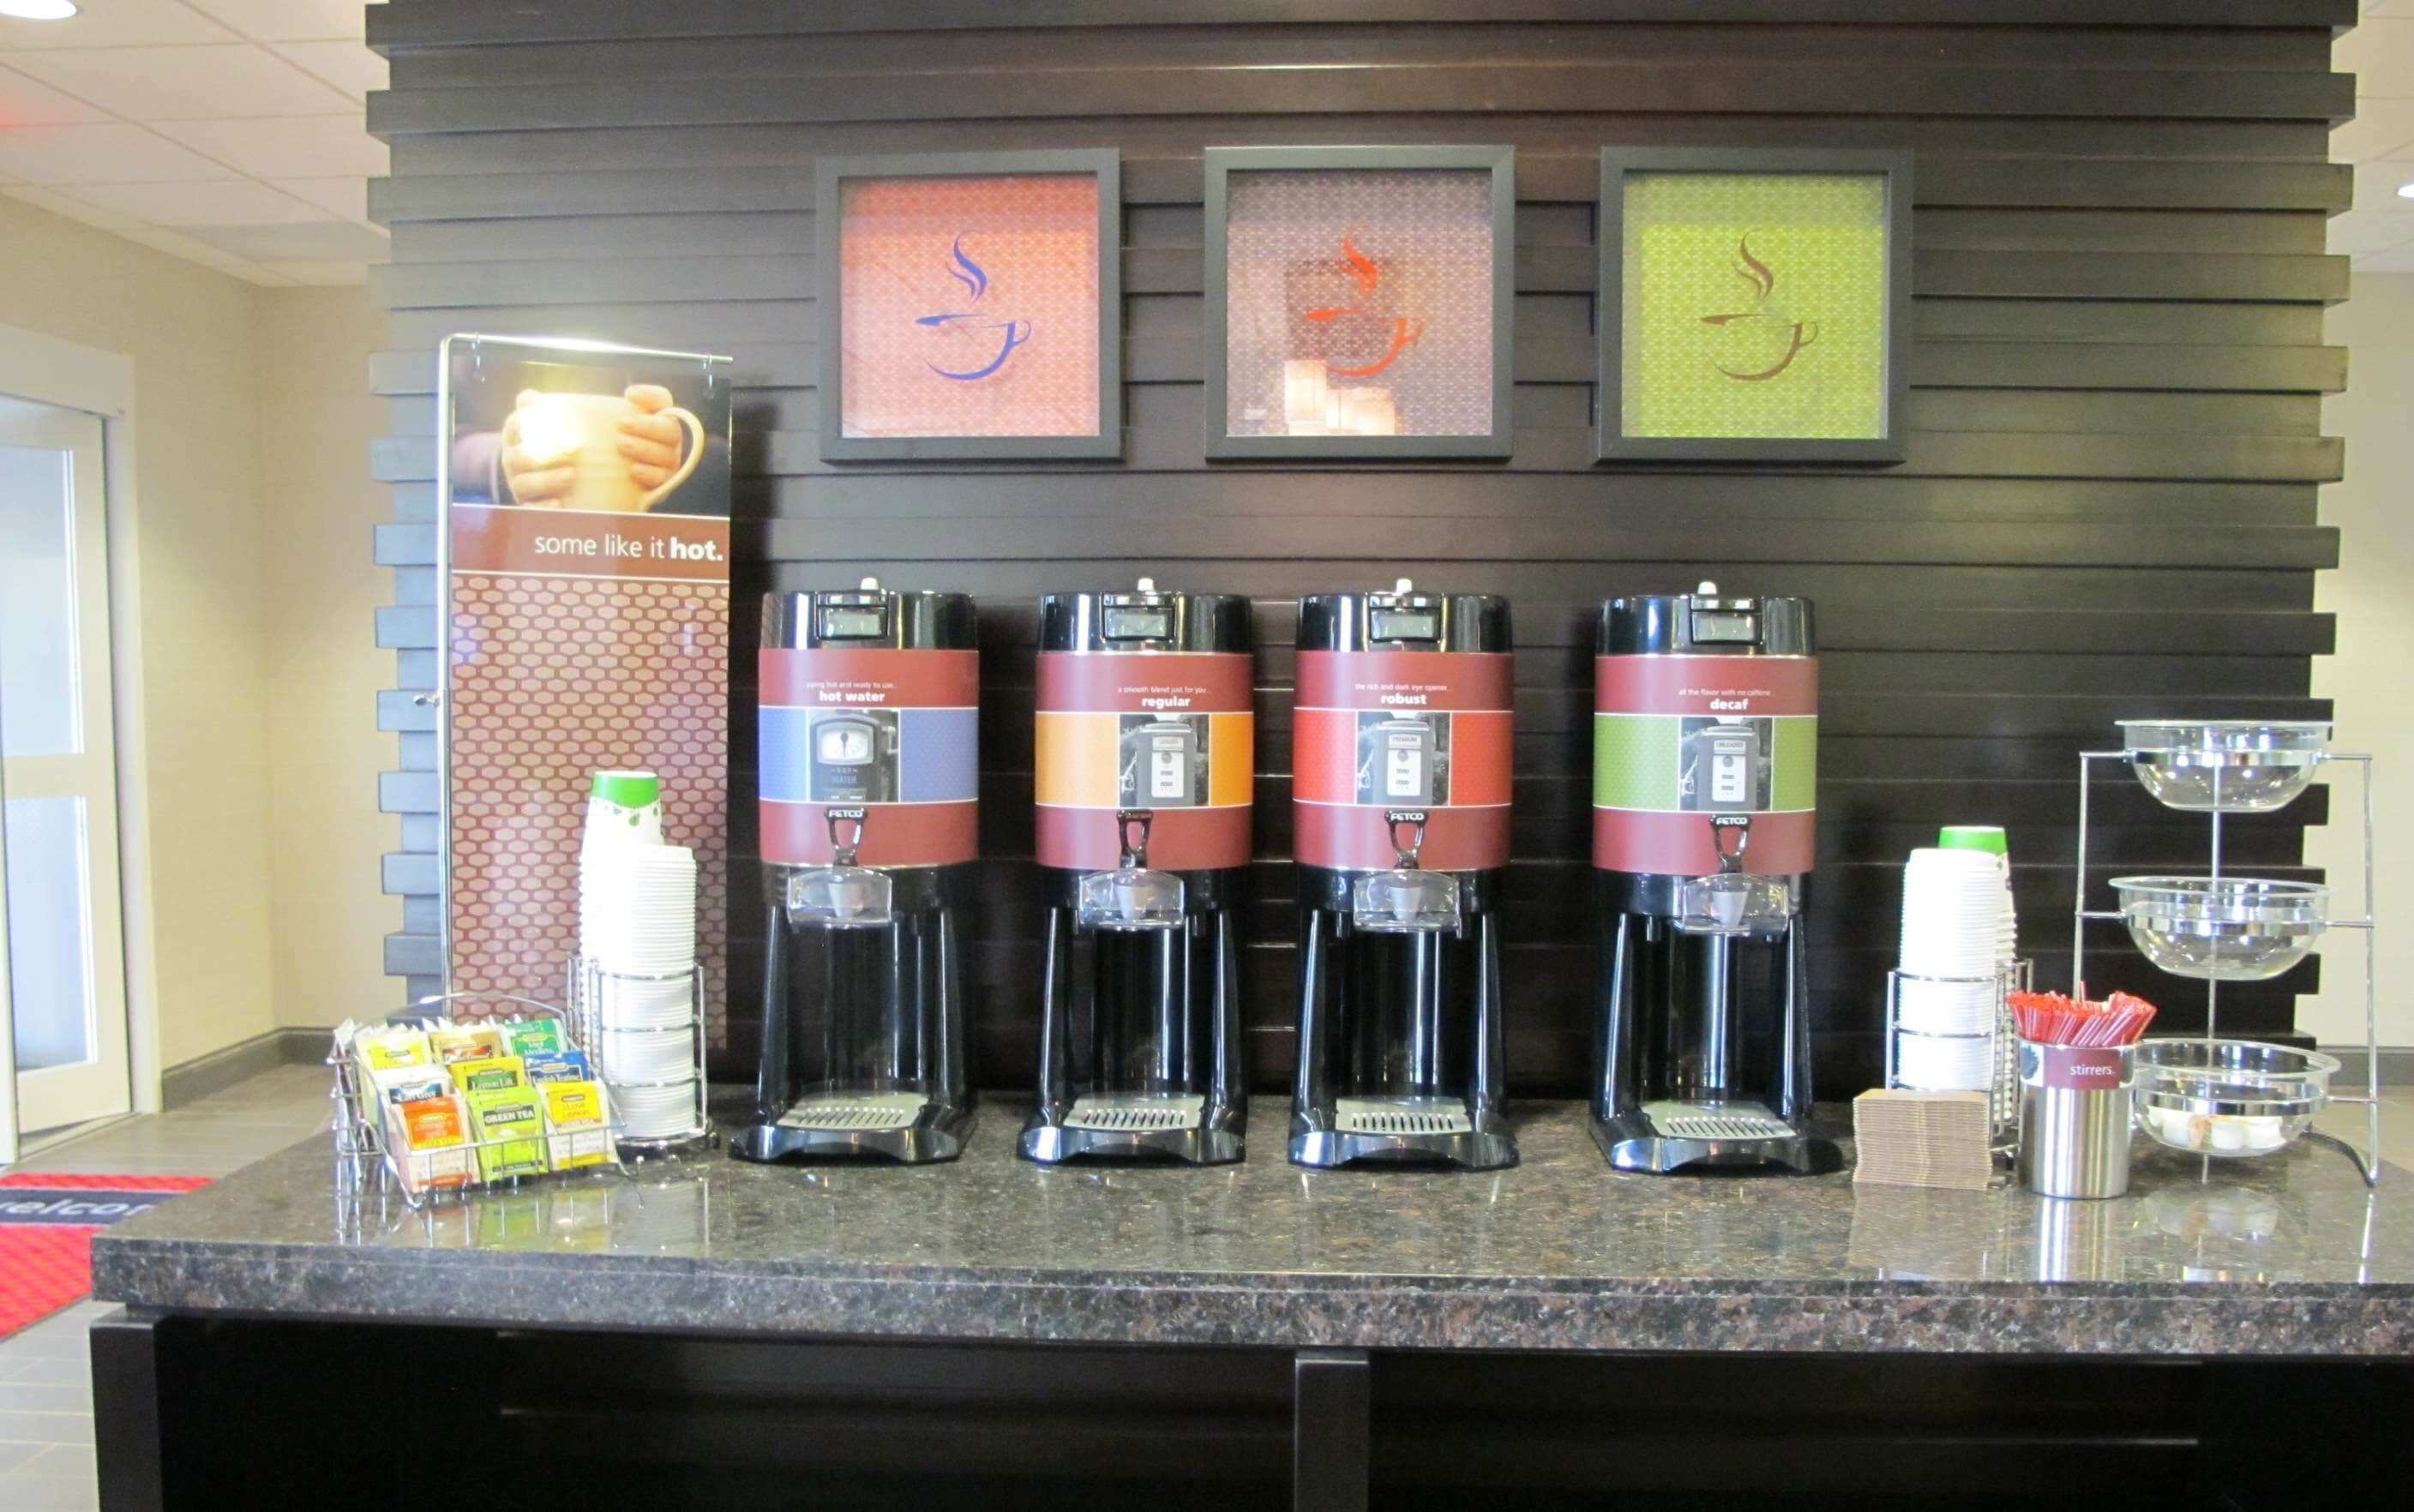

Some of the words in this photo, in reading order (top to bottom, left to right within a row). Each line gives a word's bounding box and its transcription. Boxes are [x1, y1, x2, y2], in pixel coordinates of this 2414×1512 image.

[534, 536, 597, 555] some
[604, 534, 642, 558] like
[651, 537, 664, 559] it
[670, 537, 724, 561] hot.
[853, 681, 872, 690] ready
[819, 690, 842, 702] hot
[845, 691, 886, 702] water
[1380, 693, 1427, 705] robust
[1142, 695, 1192, 710] regular
[1709, 698, 1749, 710] decaf
[828, 809, 864, 819] FETCO
[1390, 813, 1425, 821] FETCO
[1716, 817, 1748, 825] FETCO
[485, 1111, 516, 1124] GREEN
[518, 1110, 535, 1120] TEA
